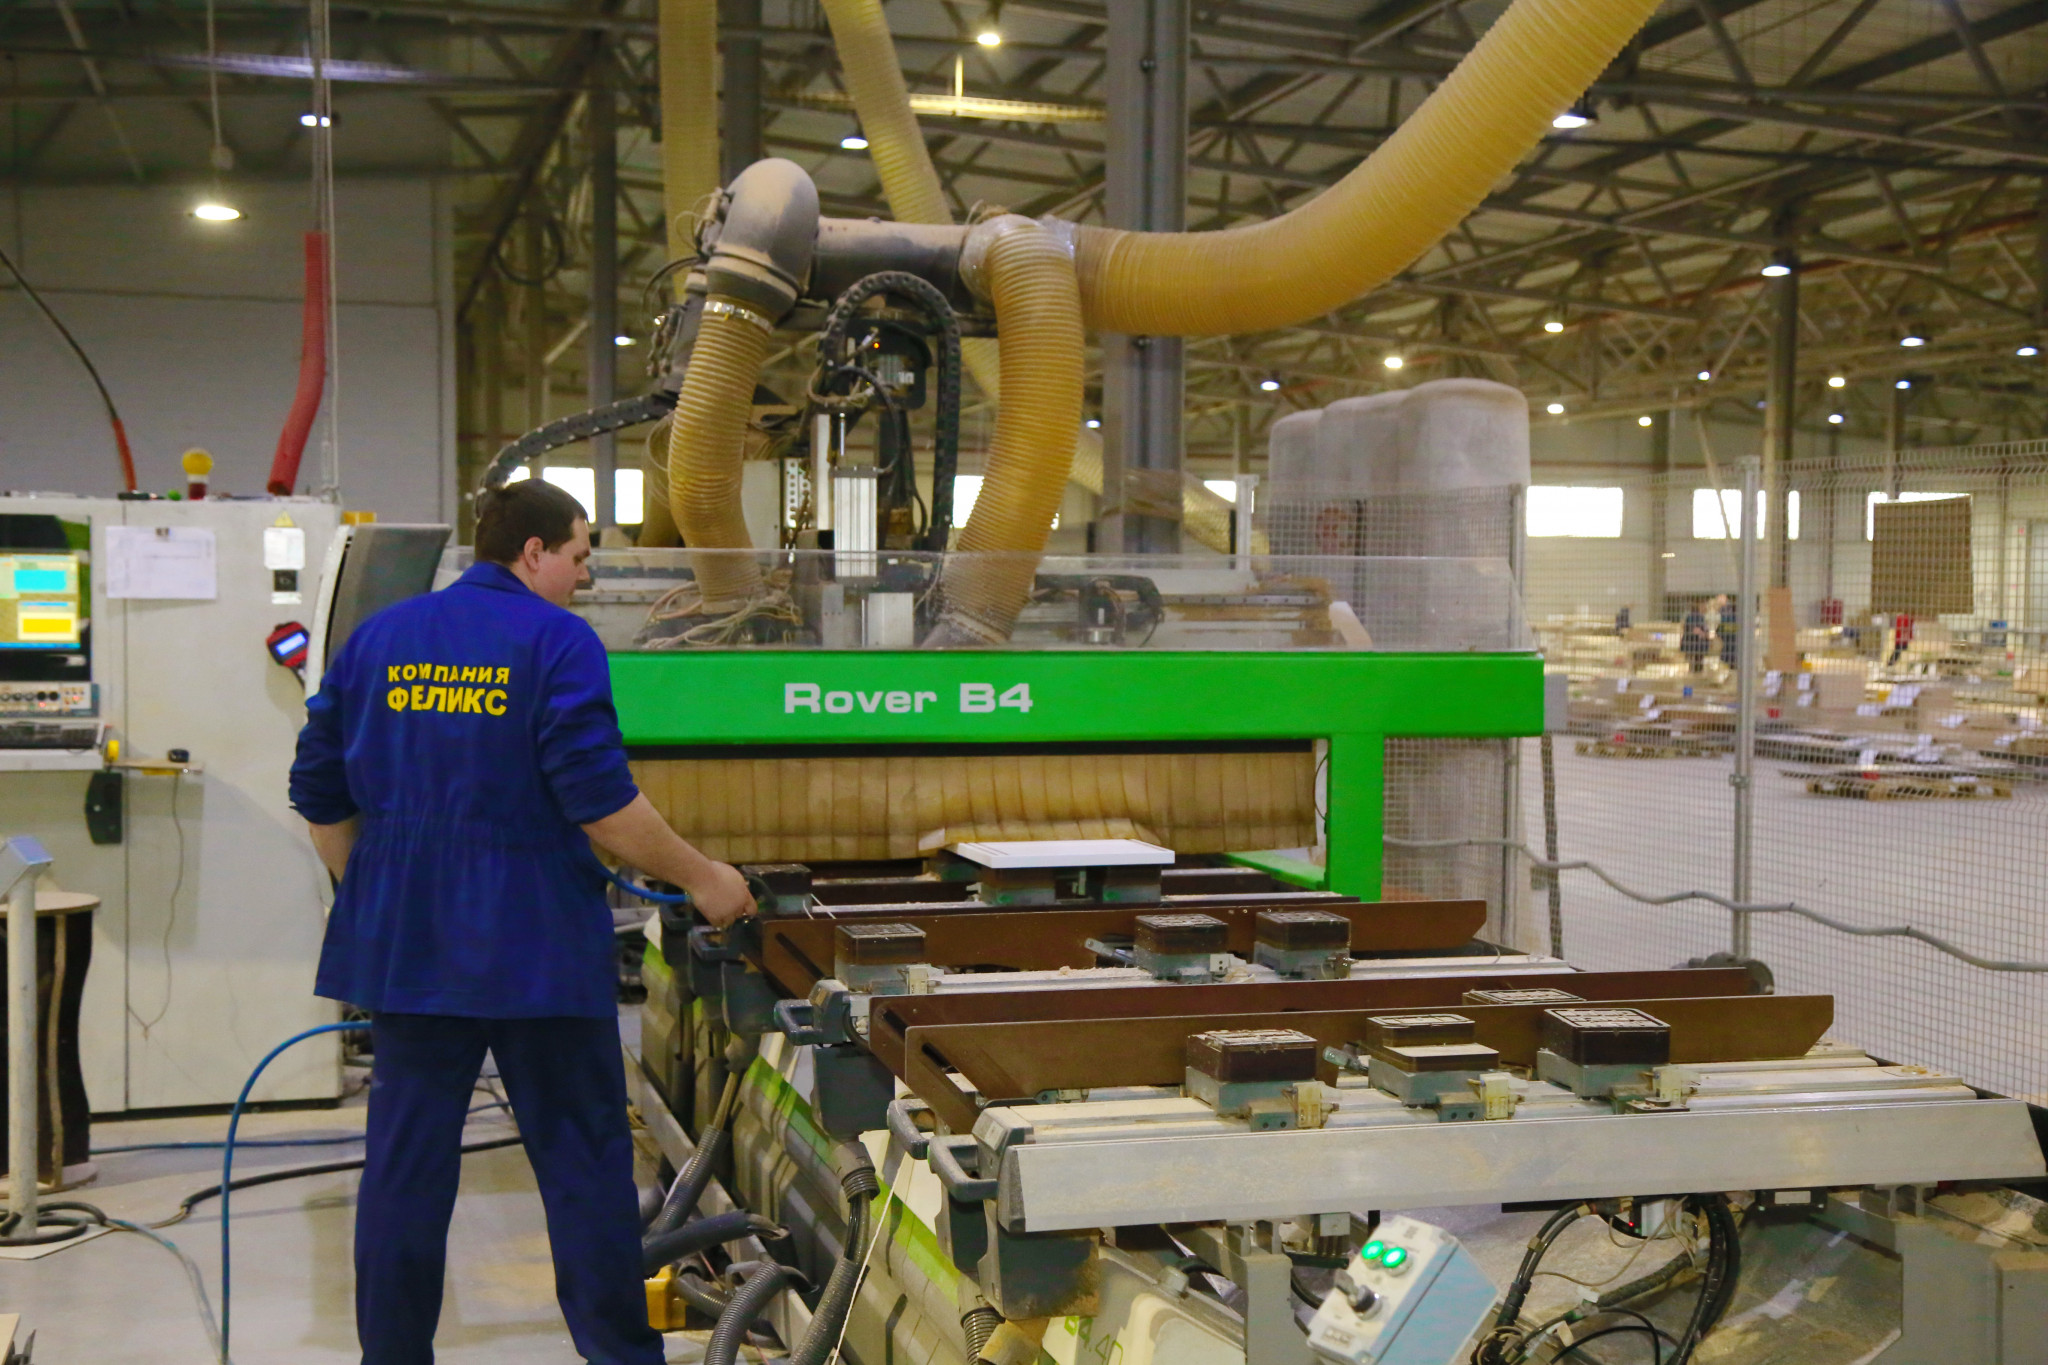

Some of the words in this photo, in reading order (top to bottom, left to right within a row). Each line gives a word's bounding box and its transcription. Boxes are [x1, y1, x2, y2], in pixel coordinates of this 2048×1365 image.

[388, 663, 510, 685] КОМПАНИЯ
[387, 685, 508, 716] ФЕЛИКС
[784, 682, 938, 714] Rover
[959, 682, 1033, 713] B4
